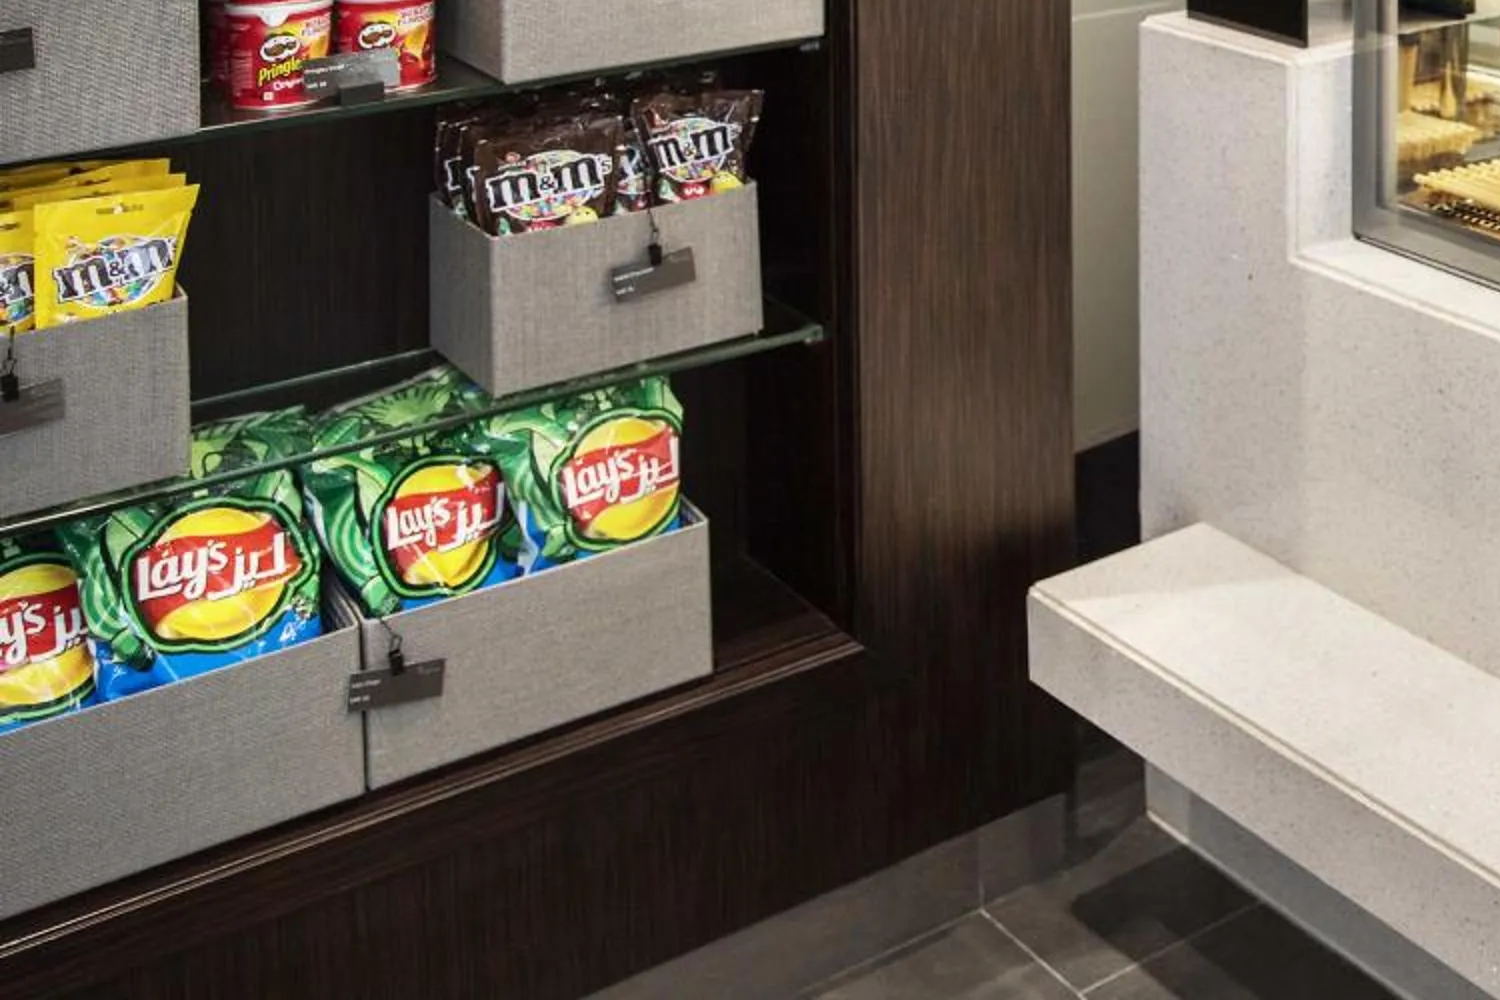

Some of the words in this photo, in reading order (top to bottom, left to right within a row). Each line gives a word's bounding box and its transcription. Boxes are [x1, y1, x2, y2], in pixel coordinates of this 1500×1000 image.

[562, 447, 638, 509] Lay's
[386, 496, 452, 552] Lay's
[137, 538, 229, 602] Lay's
